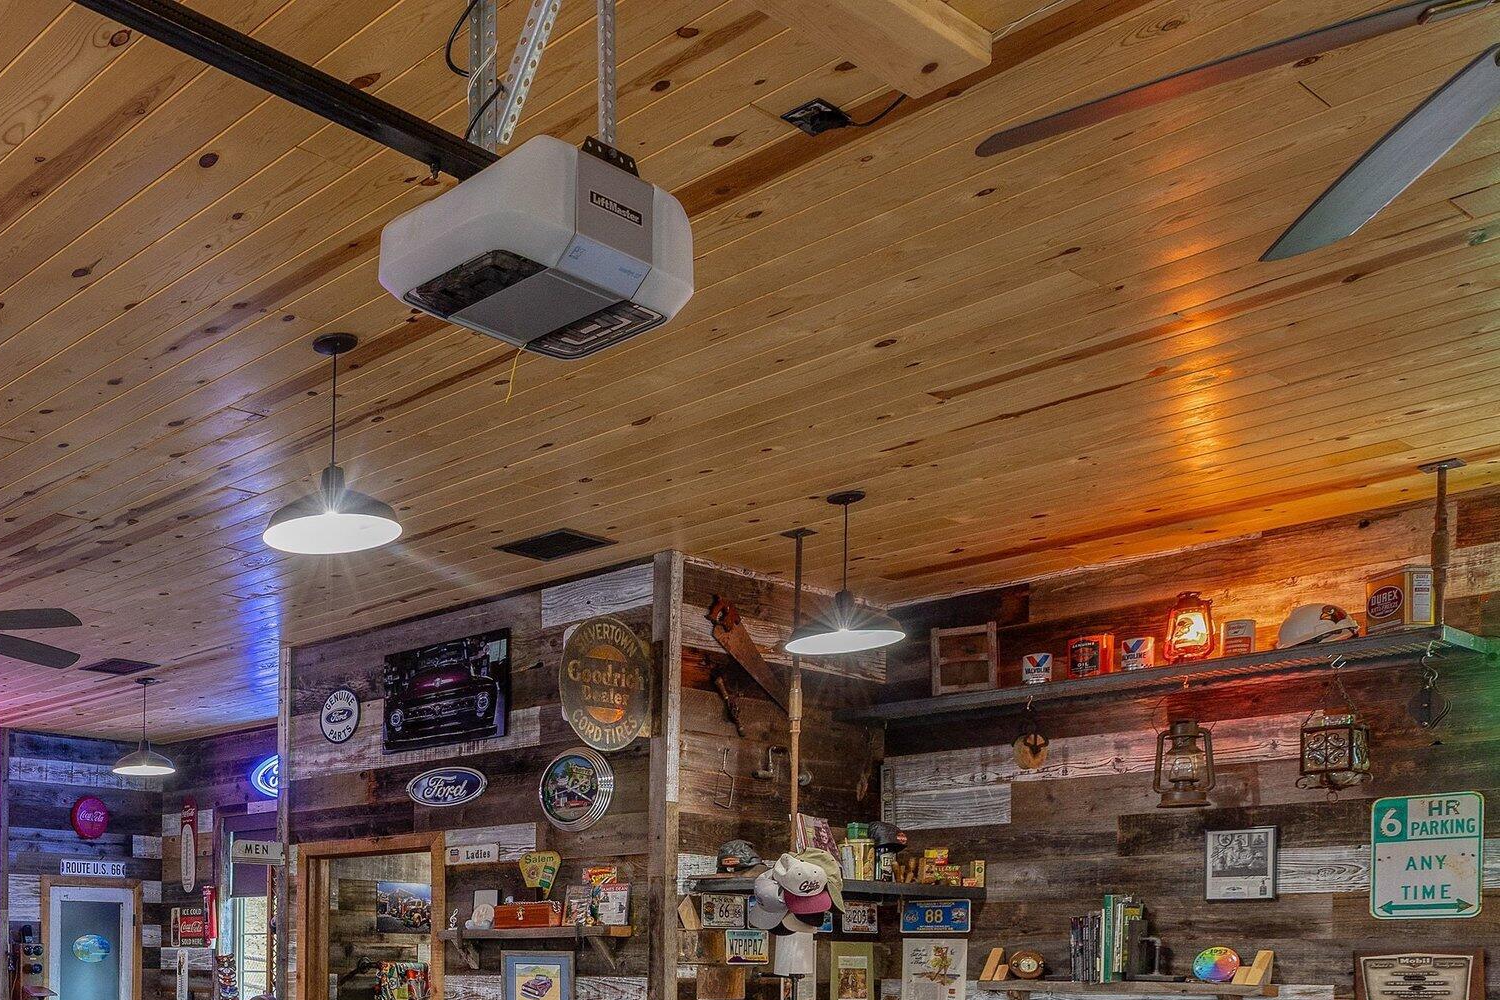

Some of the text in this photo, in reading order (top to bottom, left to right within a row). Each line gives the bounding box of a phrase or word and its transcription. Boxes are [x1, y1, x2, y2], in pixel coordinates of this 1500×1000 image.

[593, 193, 640, 222] LiftMaster
[1371, 590, 1398, 606] DUREX
[325, 691, 355, 710] GENUINE
[328, 725, 352, 740] PARTS
[423, 775, 467, 799] Ford
[1428, 800, 1460, 816] HR
[1381, 807, 1402, 837] 6
[1410, 818, 1476, 836] PARKING
[245, 844, 269, 855] MEN
[465, 849, 491, 860] Ladies
[525, 855, 554, 864] Salem
[1405, 855, 1447, 871] ANY
[66, 862, 121, 875] ROUTE U.S. 66
[1401, 884, 1451, 900] TIME
[719, 904, 730, 918] 66
[925, 908, 943, 923] 88
[1400, 957, 1431, 965] Mobil
